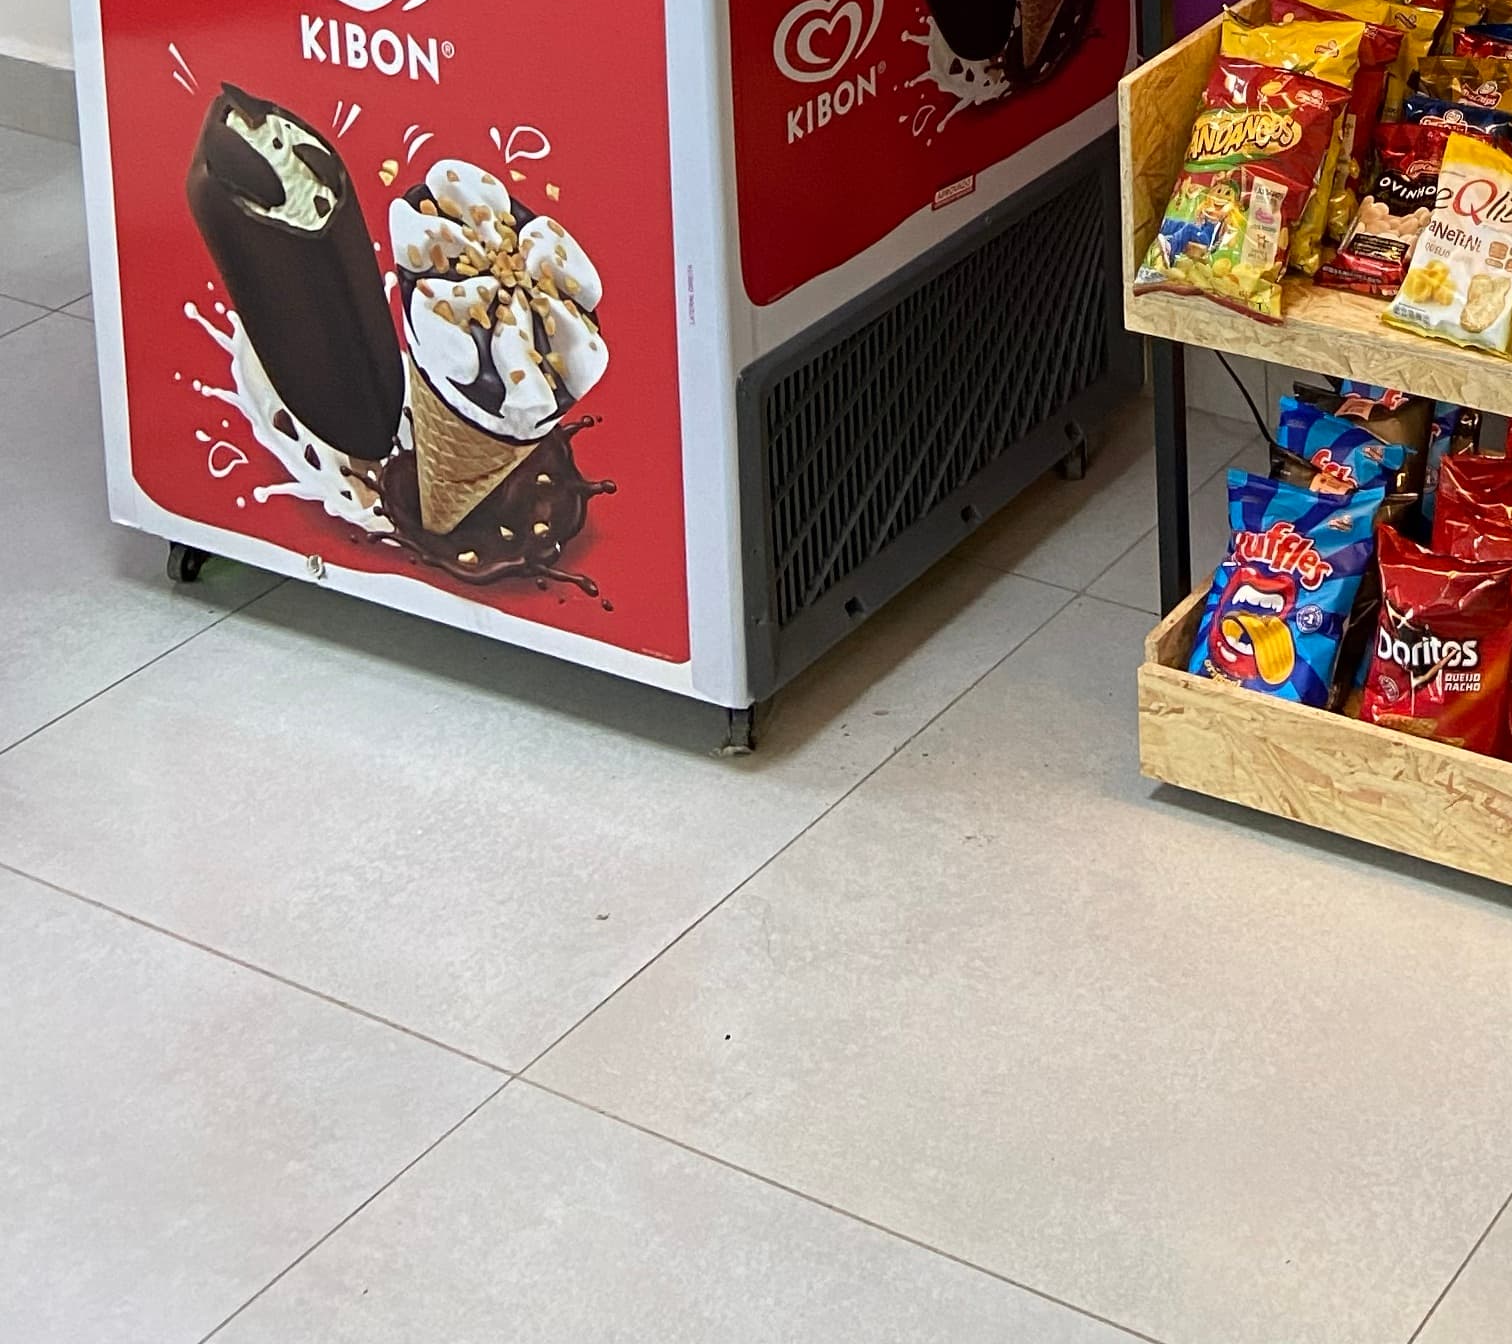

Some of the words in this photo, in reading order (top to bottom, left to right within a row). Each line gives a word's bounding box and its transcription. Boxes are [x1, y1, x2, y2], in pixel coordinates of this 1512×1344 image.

[1189, 113, 1296, 161] ANDANGOS
[1376, 626, 1478, 668] Doritos
[1444, 672, 1481, 683] QUEIJO
[1444, 683, 1481, 692] NACHO
